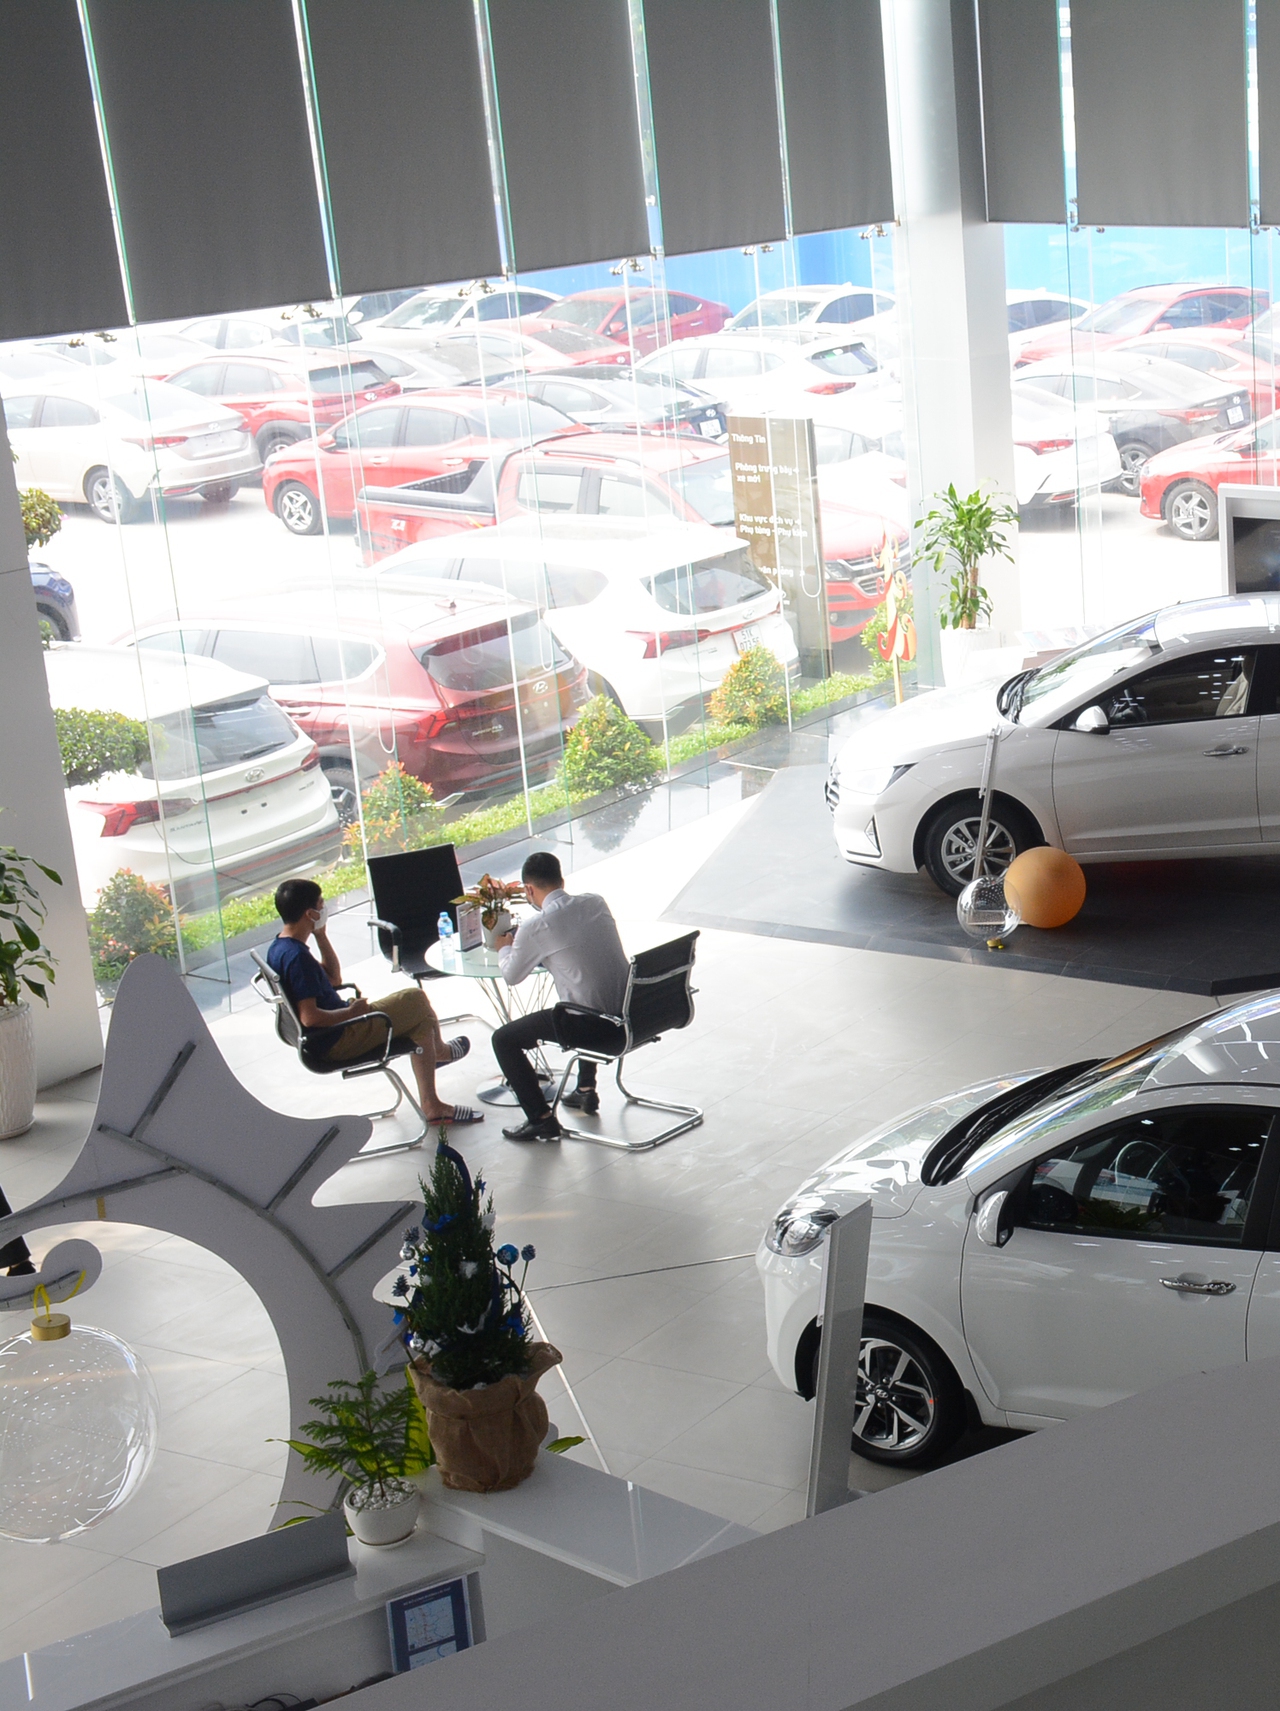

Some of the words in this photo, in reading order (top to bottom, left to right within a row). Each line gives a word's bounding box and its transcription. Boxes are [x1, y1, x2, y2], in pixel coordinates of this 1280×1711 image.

[754, 435, 766, 444] Tin
[758, 464, 778, 475] trưg
[769, 515, 783, 525] dch
